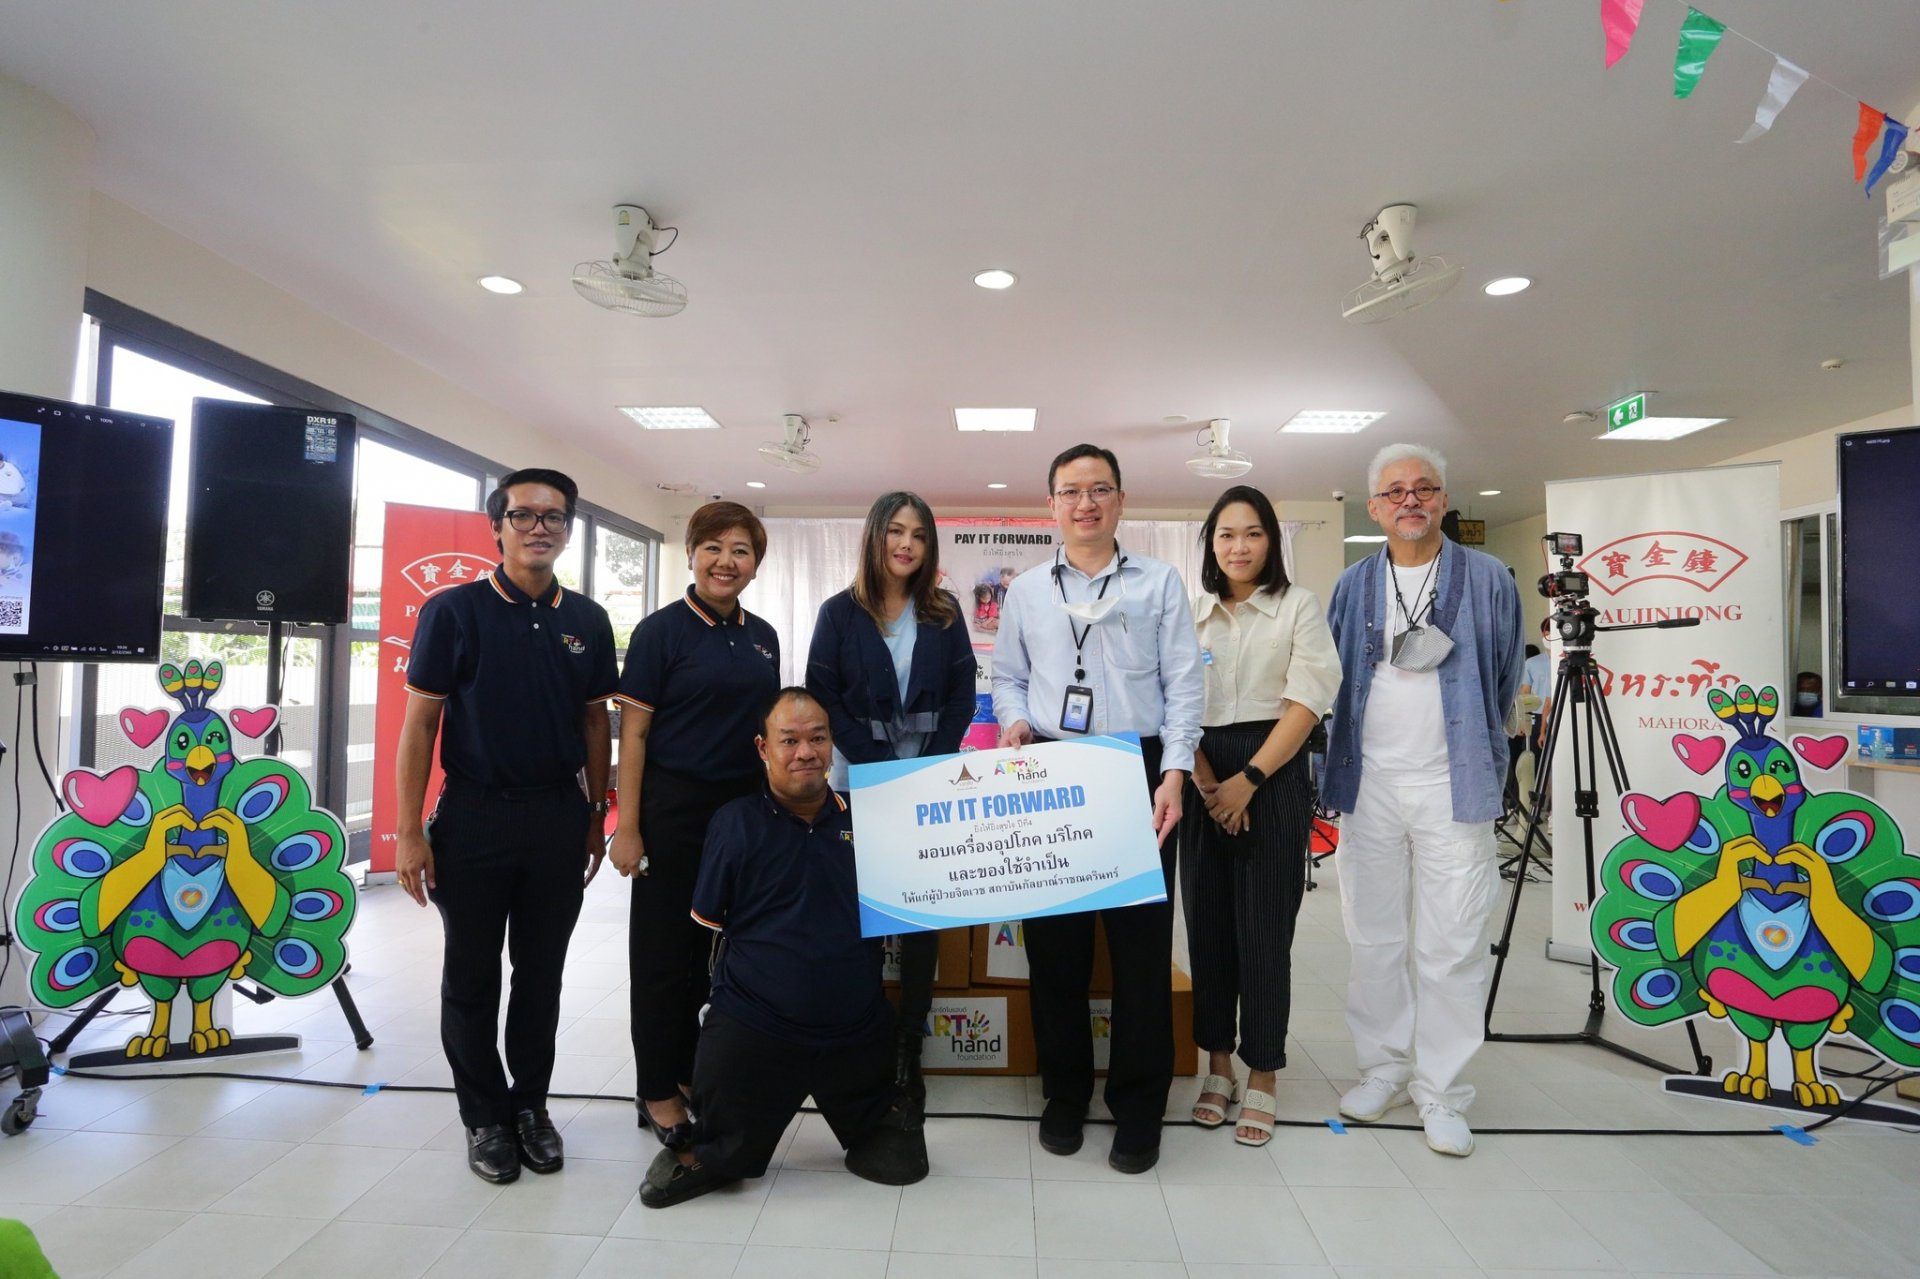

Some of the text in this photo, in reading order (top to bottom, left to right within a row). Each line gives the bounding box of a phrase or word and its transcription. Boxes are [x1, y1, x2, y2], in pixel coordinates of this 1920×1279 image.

[306, 415, 337, 425] DXR15
[954, 533, 1052, 545] PAY IT FORWARD
[1599, 604, 1743, 625] AUJINJONG
[1639, 716, 1732, 731] MAHORA
[994, 760, 1026, 776] ART
[1017, 767, 1048, 781] hand
[915, 784, 1087, 827] PAY IT FORWARD
[918, 824, 1094, 860] มอบเครื่องอุปโภค บริโภค
[948, 851, 1070, 882] และของใช้จำเป็น
[902, 886, 986, 905] ให้แก่ผู้ป่วยจิตเวช
[951, 1034, 1001, 1053] hand
[957, 1052, 997, 1062] foundation
